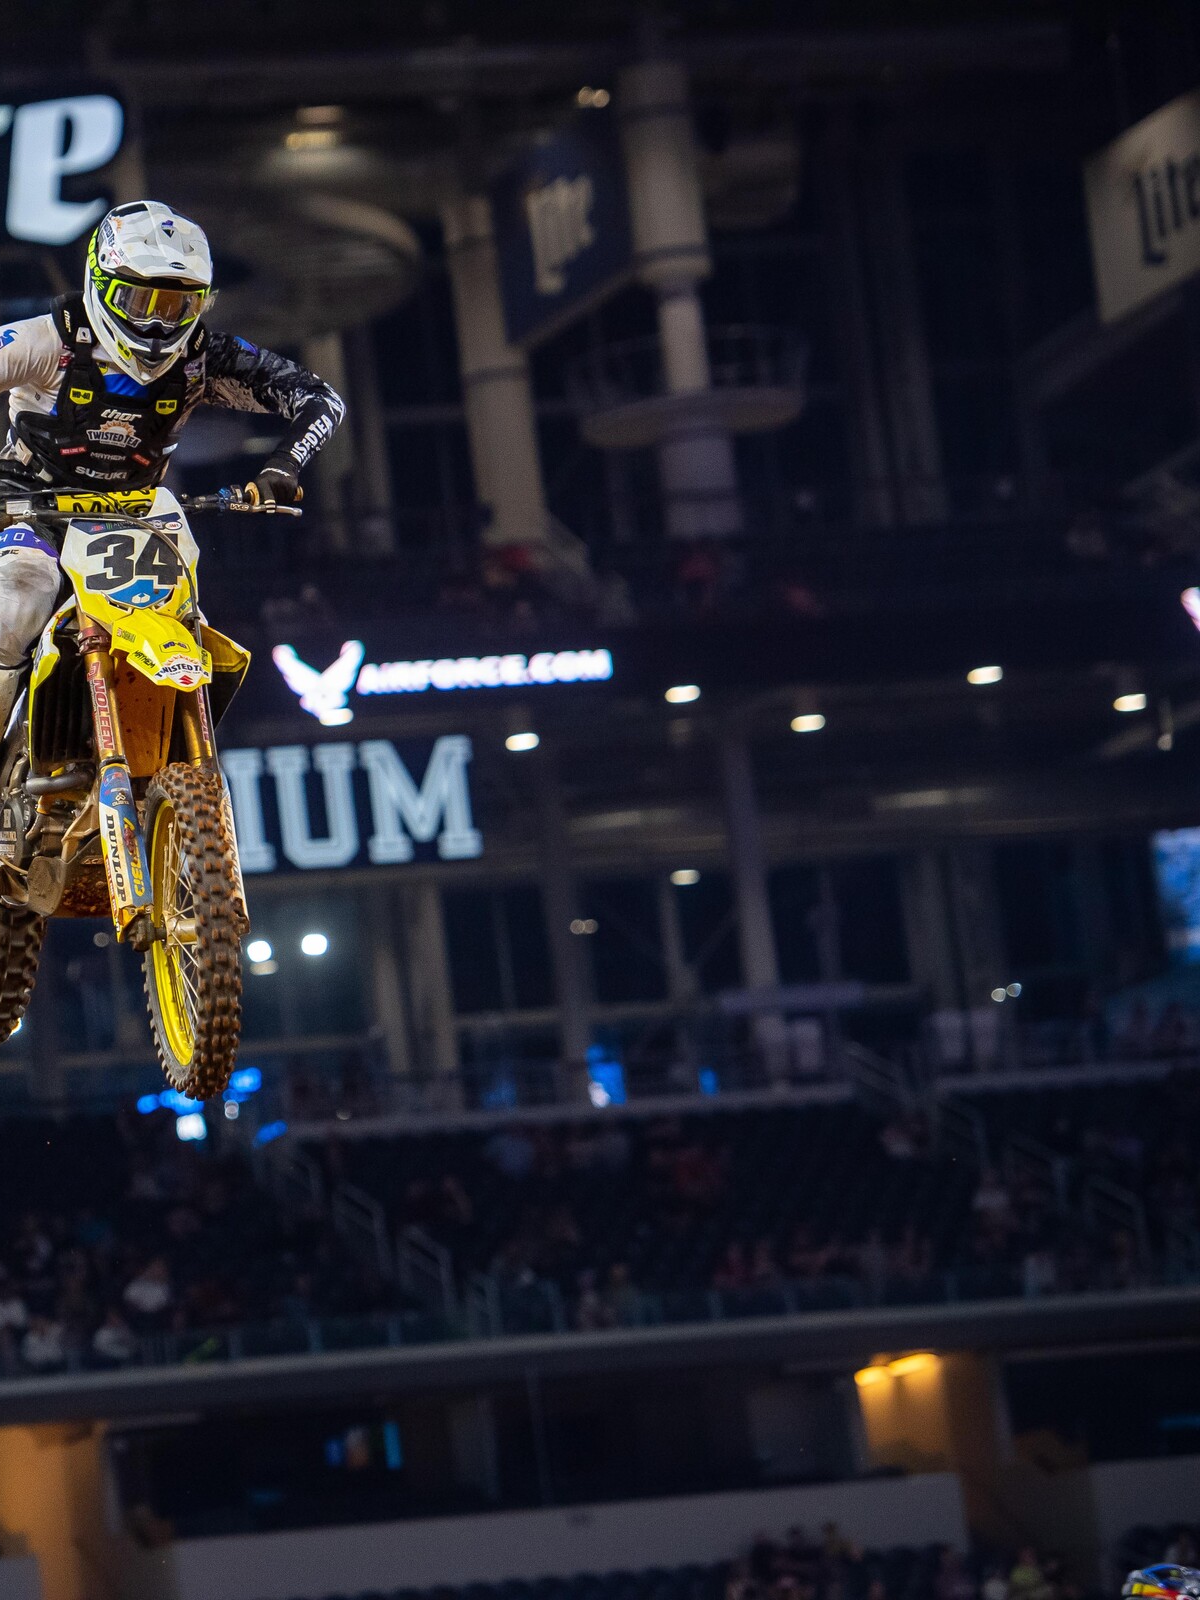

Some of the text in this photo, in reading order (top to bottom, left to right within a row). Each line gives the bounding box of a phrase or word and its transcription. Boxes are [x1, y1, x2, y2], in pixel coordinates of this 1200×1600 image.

[63, 309, 72, 333] thor
[71, 390, 91, 400] WD-40
[101, 409, 143, 421] thor
[87, 430, 124, 442] TWISTED
[123, 436, 141, 448] TEA
[90, 451, 127, 461] MAYHEM
[75, 465, 128, 480] SUZUKI
[85, 532, 184, 592] 34
[155, 663, 194, 678] TWISTED
[356, 649, 613, 696] AIRFORCE.COM
[93, 678, 115, 751] NOLEEN
[106, 814, 127, 902] DUNLOP
